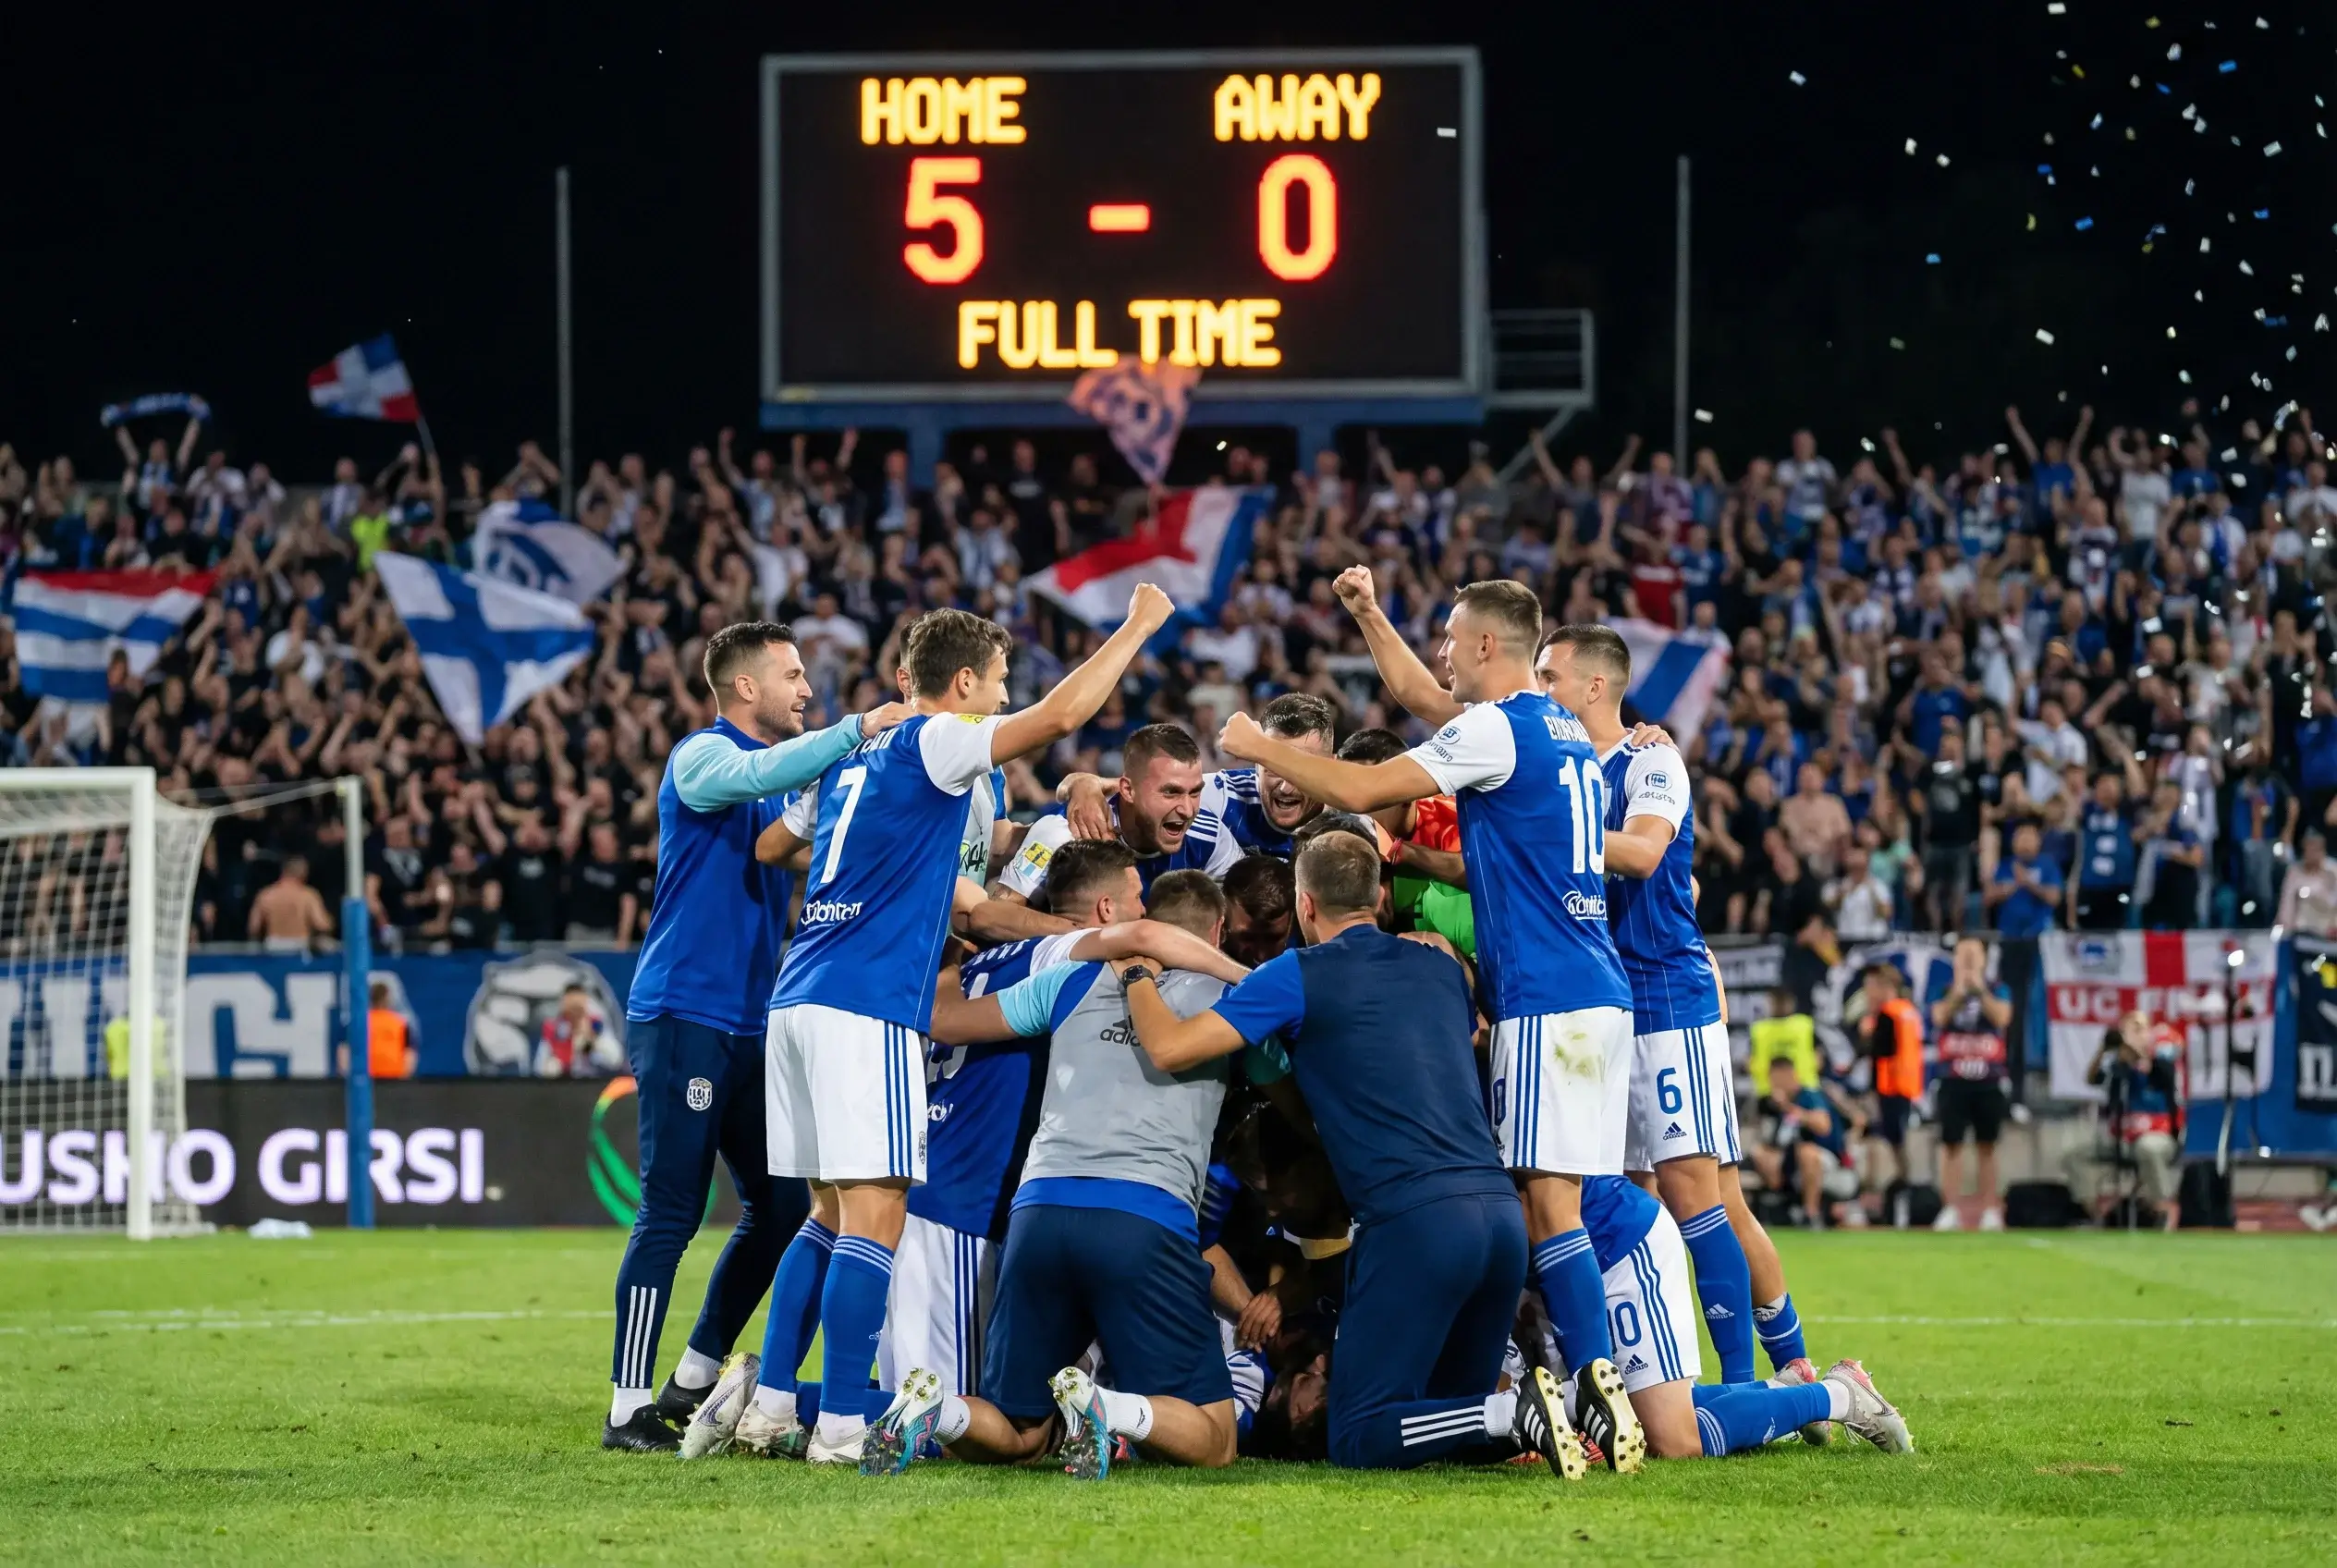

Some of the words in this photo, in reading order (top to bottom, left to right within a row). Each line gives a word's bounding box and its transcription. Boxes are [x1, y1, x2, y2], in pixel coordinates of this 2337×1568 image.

[861, 77, 1027, 145] HOME
[1214, 73, 1381, 141] AWAY
[903, 155, 985, 285] 5
[1257, 153, 1339, 281] 0
[958, 300, 1119, 369] FULL
[1128, 298, 1282, 367] TIME
[820, 765, 868, 885] 7
[1559, 755, 1605, 875] 10
[1656, 1066, 1682, 1115] 6
[258, 1129, 484, 1203] GIRSI
